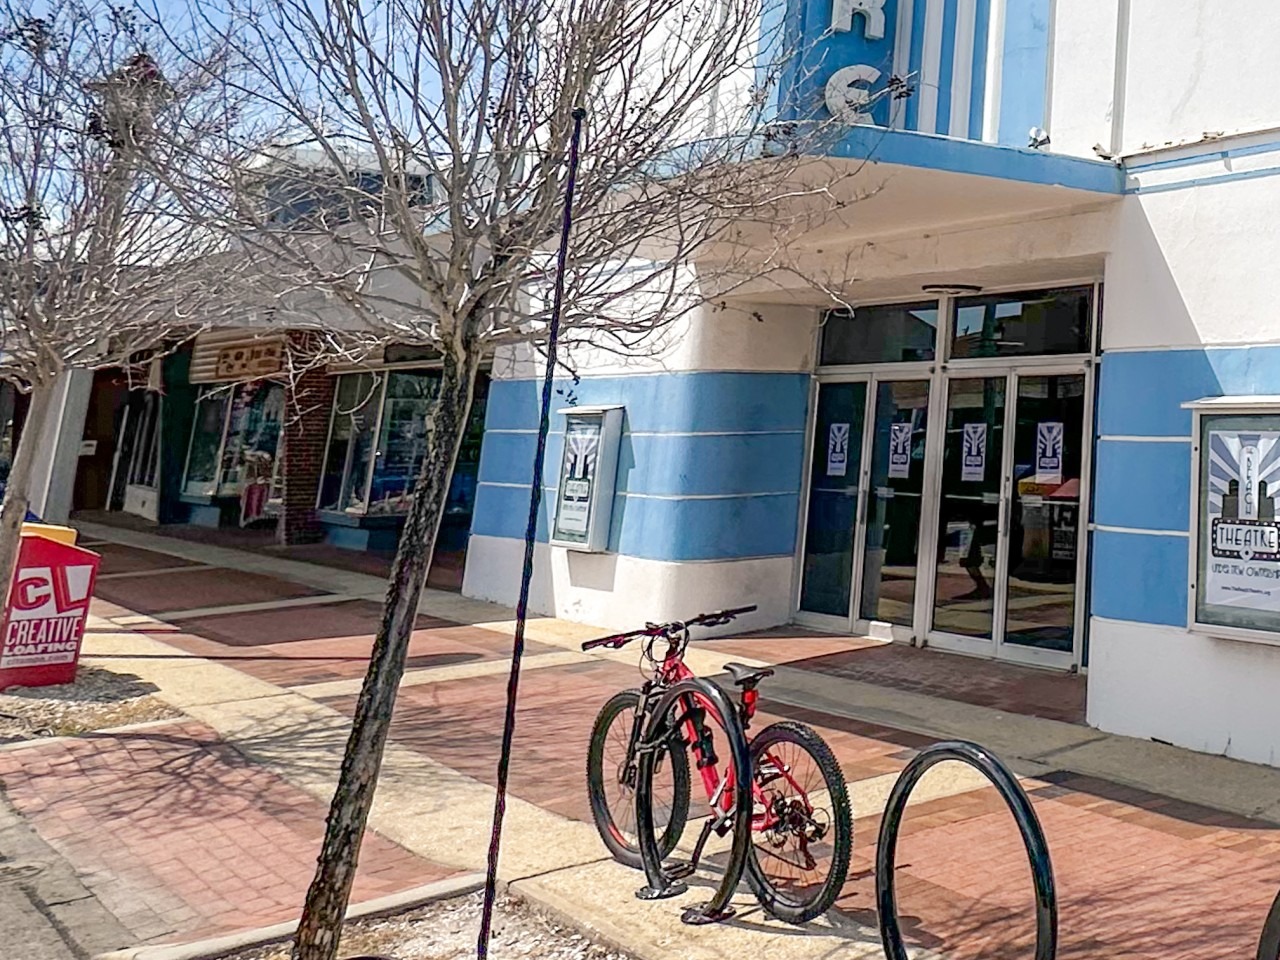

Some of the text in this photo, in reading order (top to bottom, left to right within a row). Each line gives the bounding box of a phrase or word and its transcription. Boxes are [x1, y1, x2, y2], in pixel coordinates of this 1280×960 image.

[1219, 526, 1276, 549] THEATRE
[12, 565, 92, 615] CL
[4, 616, 83, 647] CREATIVE
[2, 641, 78, 657] LOAFING
